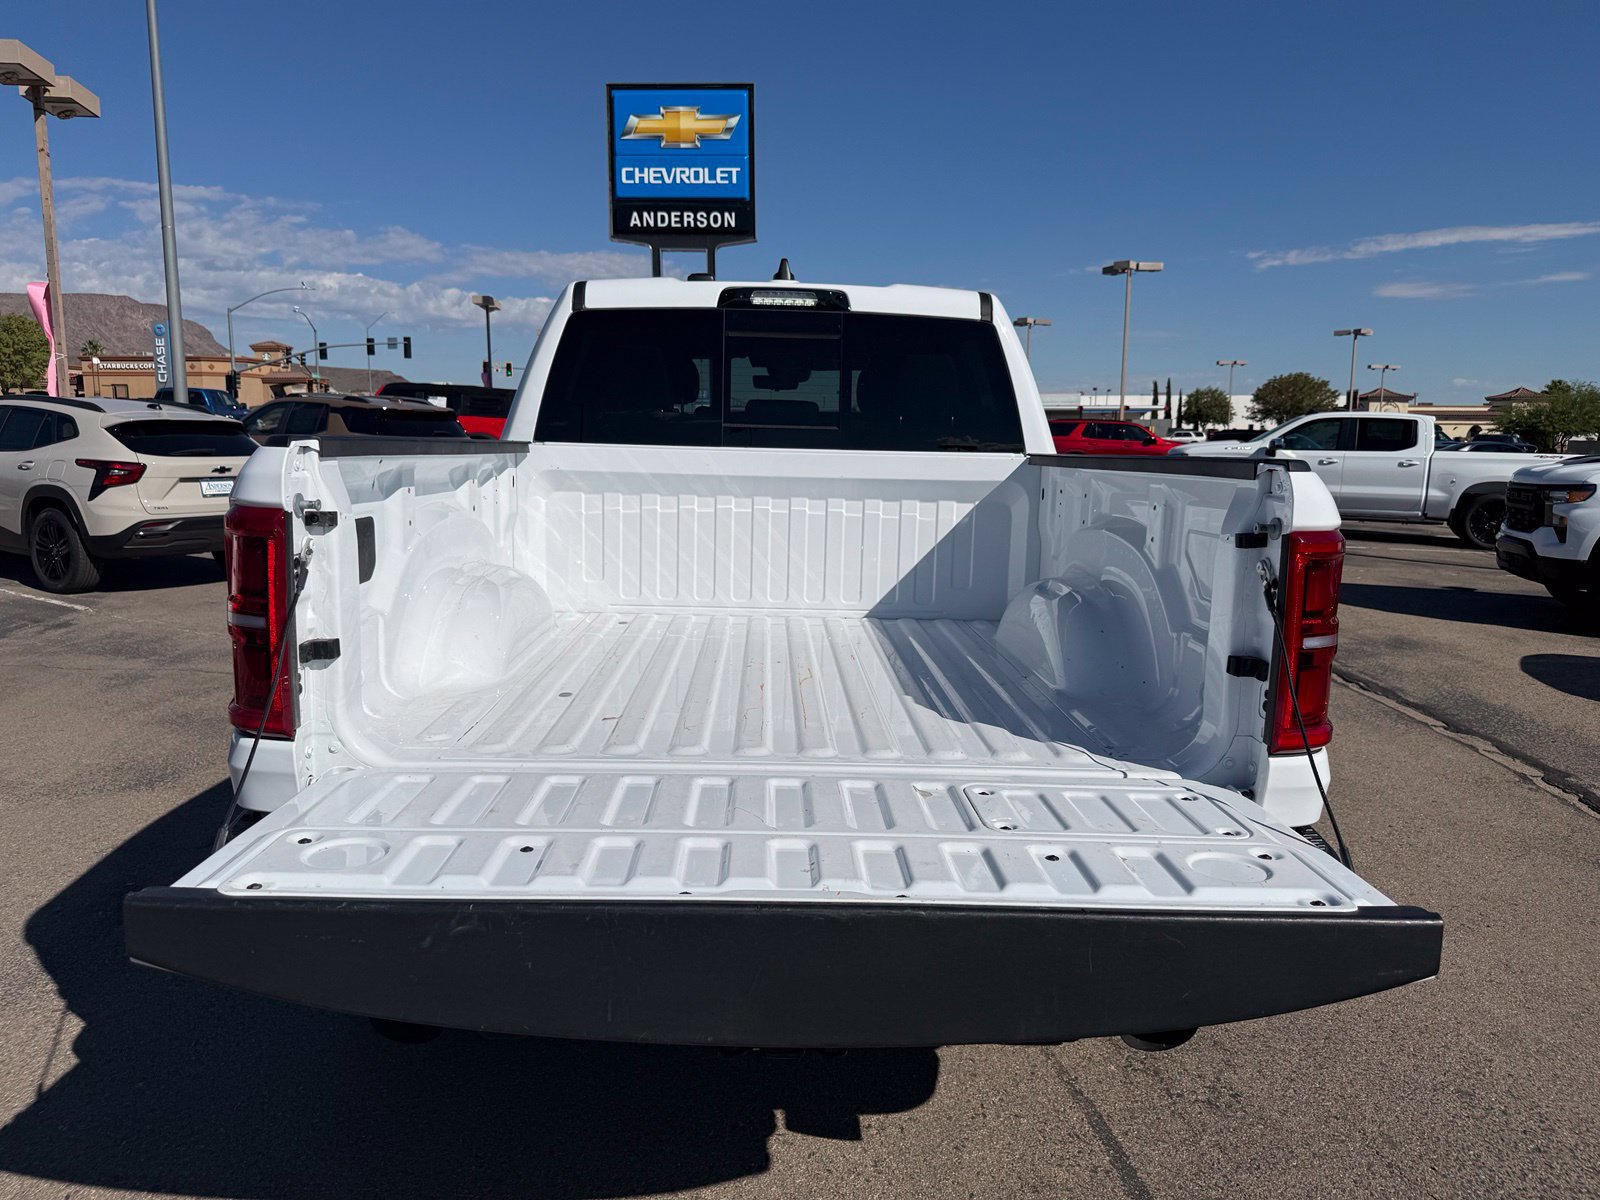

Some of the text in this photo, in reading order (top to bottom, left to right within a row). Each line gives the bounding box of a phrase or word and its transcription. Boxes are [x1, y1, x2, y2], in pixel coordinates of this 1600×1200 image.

[621, 167, 741, 184] CHEVROLET
[629, 211, 736, 228] ANDERSON
[155, 337, 168, 383] CHASE
